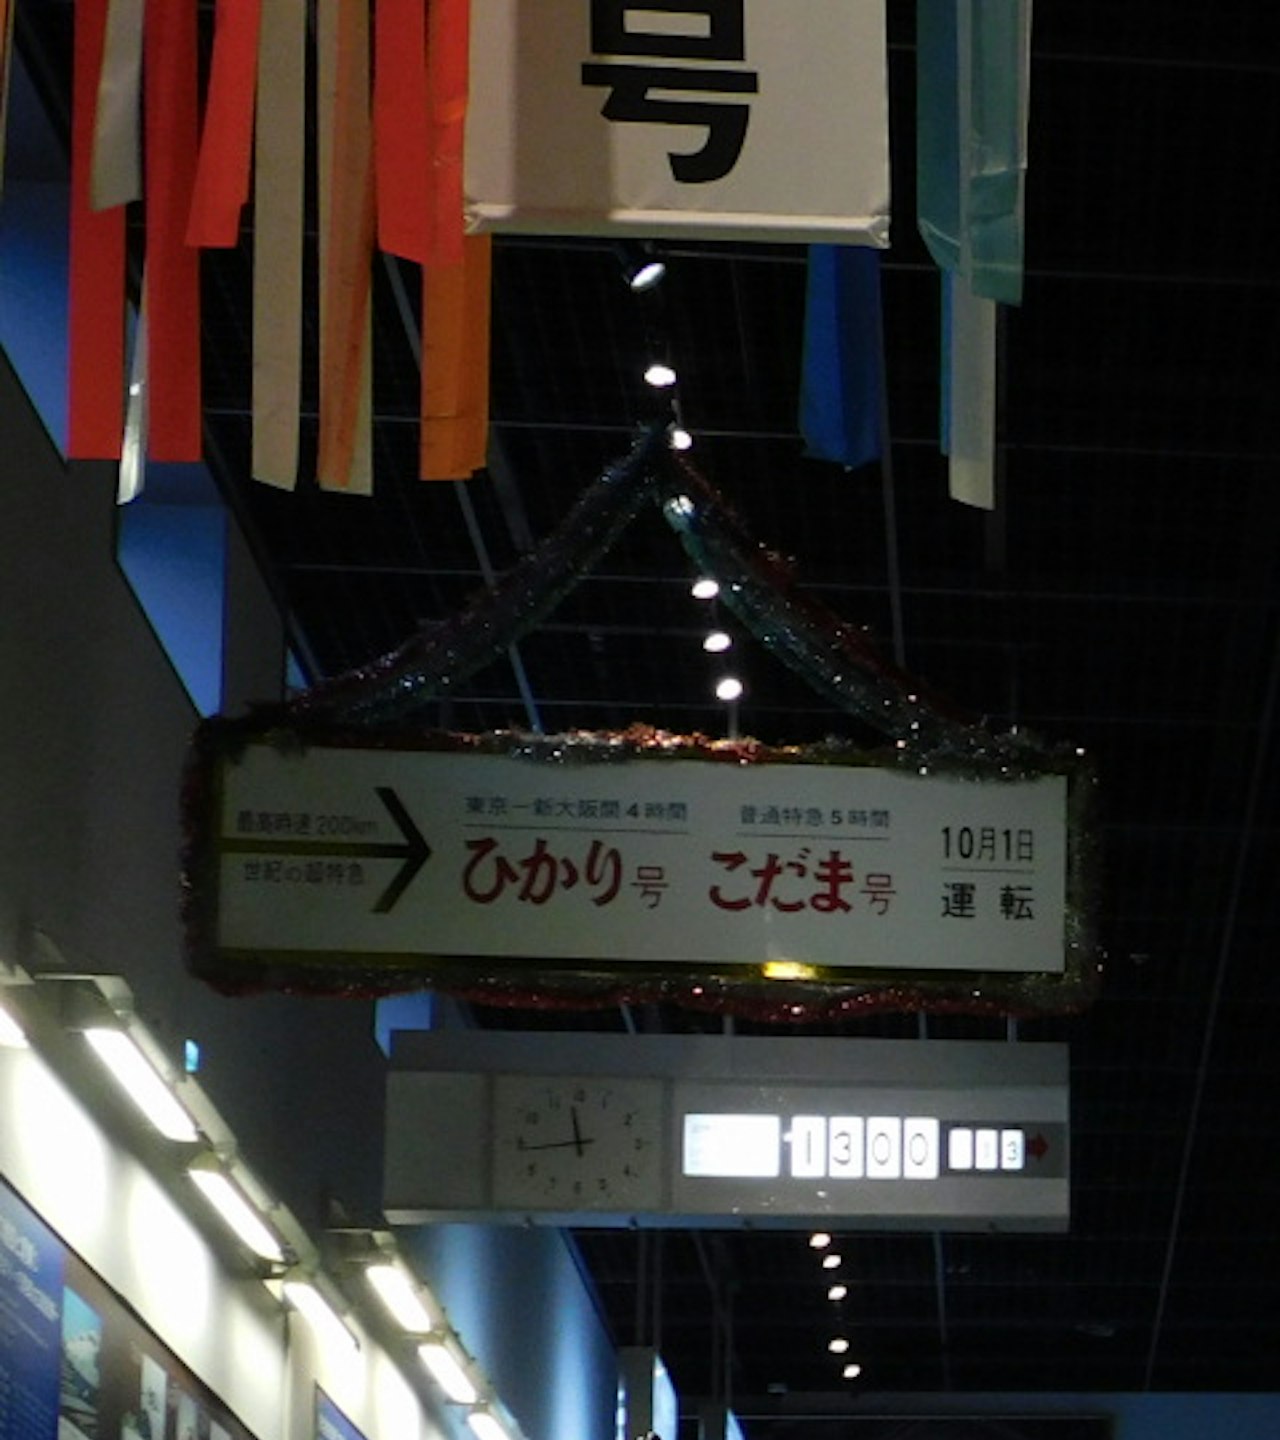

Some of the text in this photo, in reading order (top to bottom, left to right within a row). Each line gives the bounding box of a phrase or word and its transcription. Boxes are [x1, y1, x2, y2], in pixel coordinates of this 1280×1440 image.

[581, 0, 758, 184] 号
[463, 837, 897, 916] ひかり号 こだま号
[941, 826, 1034, 862] 10月1日
